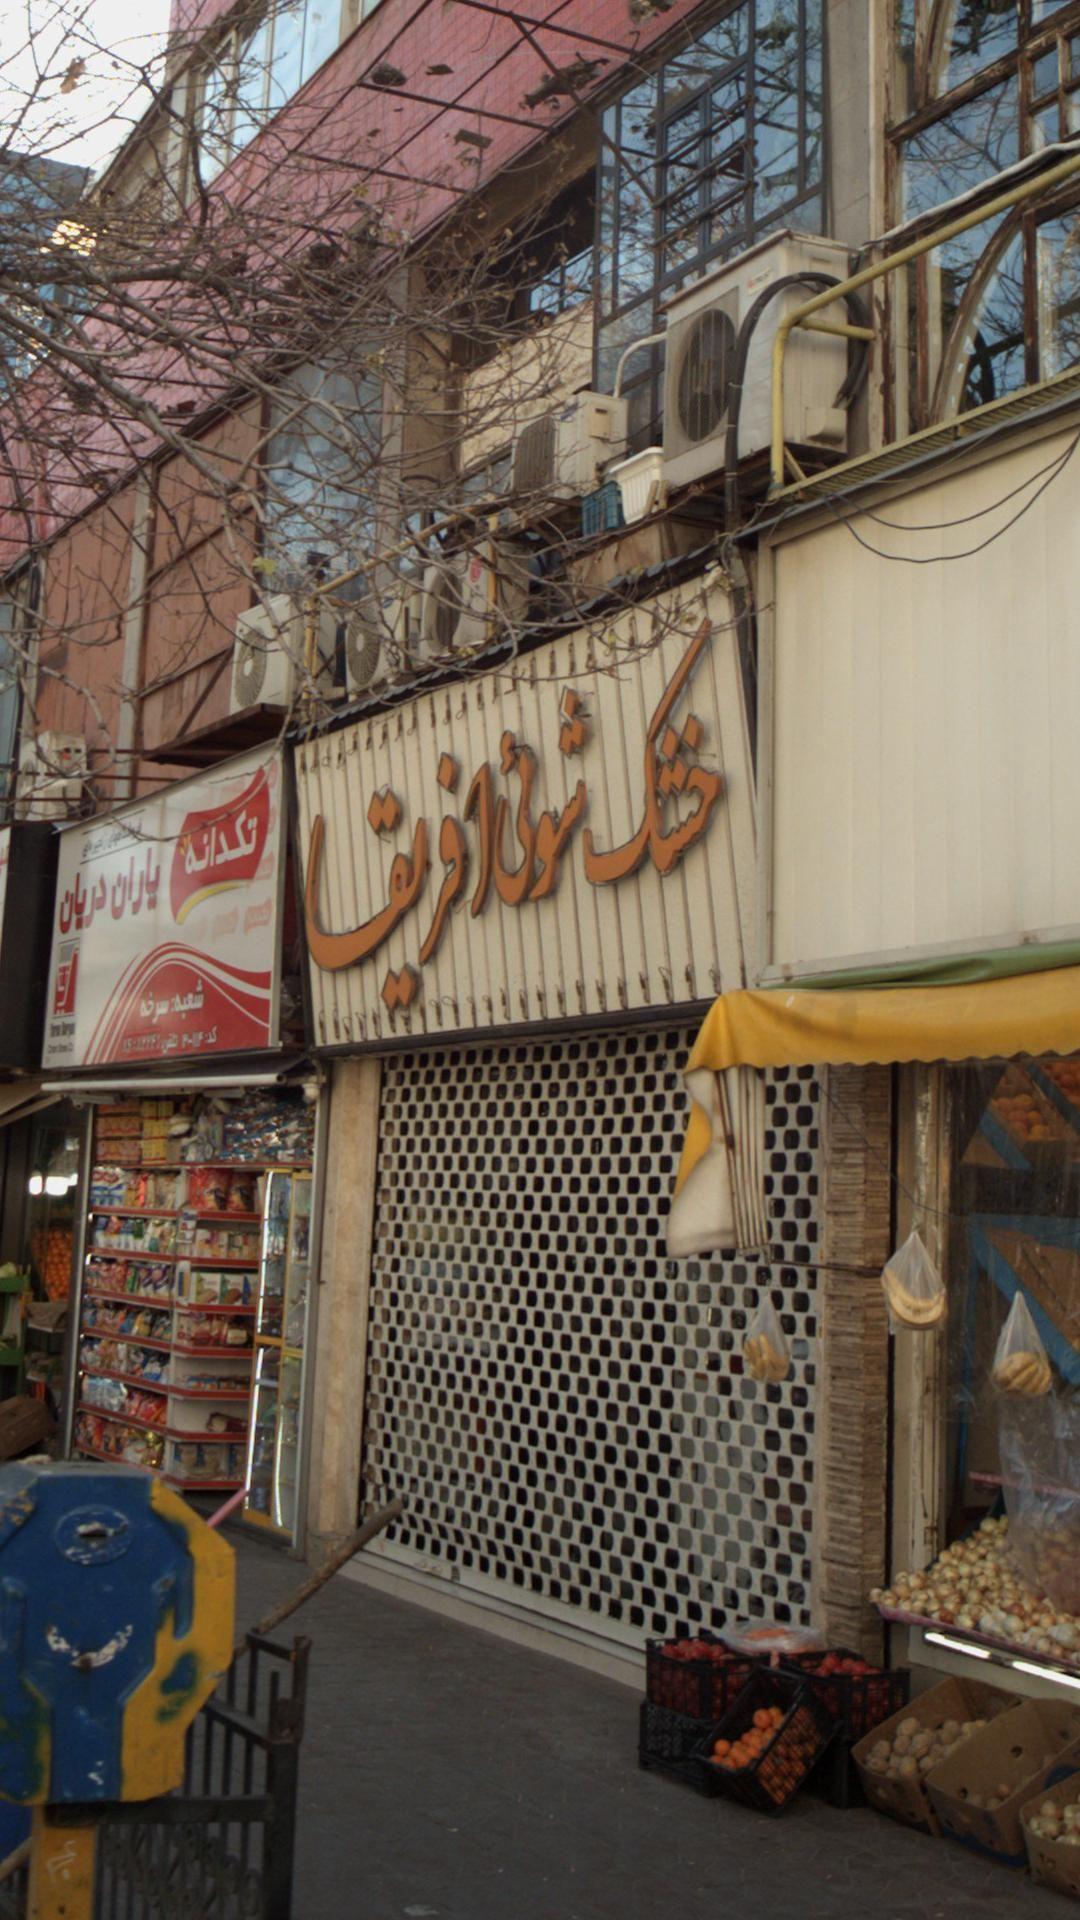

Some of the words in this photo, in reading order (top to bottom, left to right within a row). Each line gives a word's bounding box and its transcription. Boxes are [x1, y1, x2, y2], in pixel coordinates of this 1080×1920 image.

[583, 617, 725, 887] خشک
[183, 810, 259, 875] تکدانه
[59, 872, 107, 934] دریان
[111, 847, 161, 919] یاران
